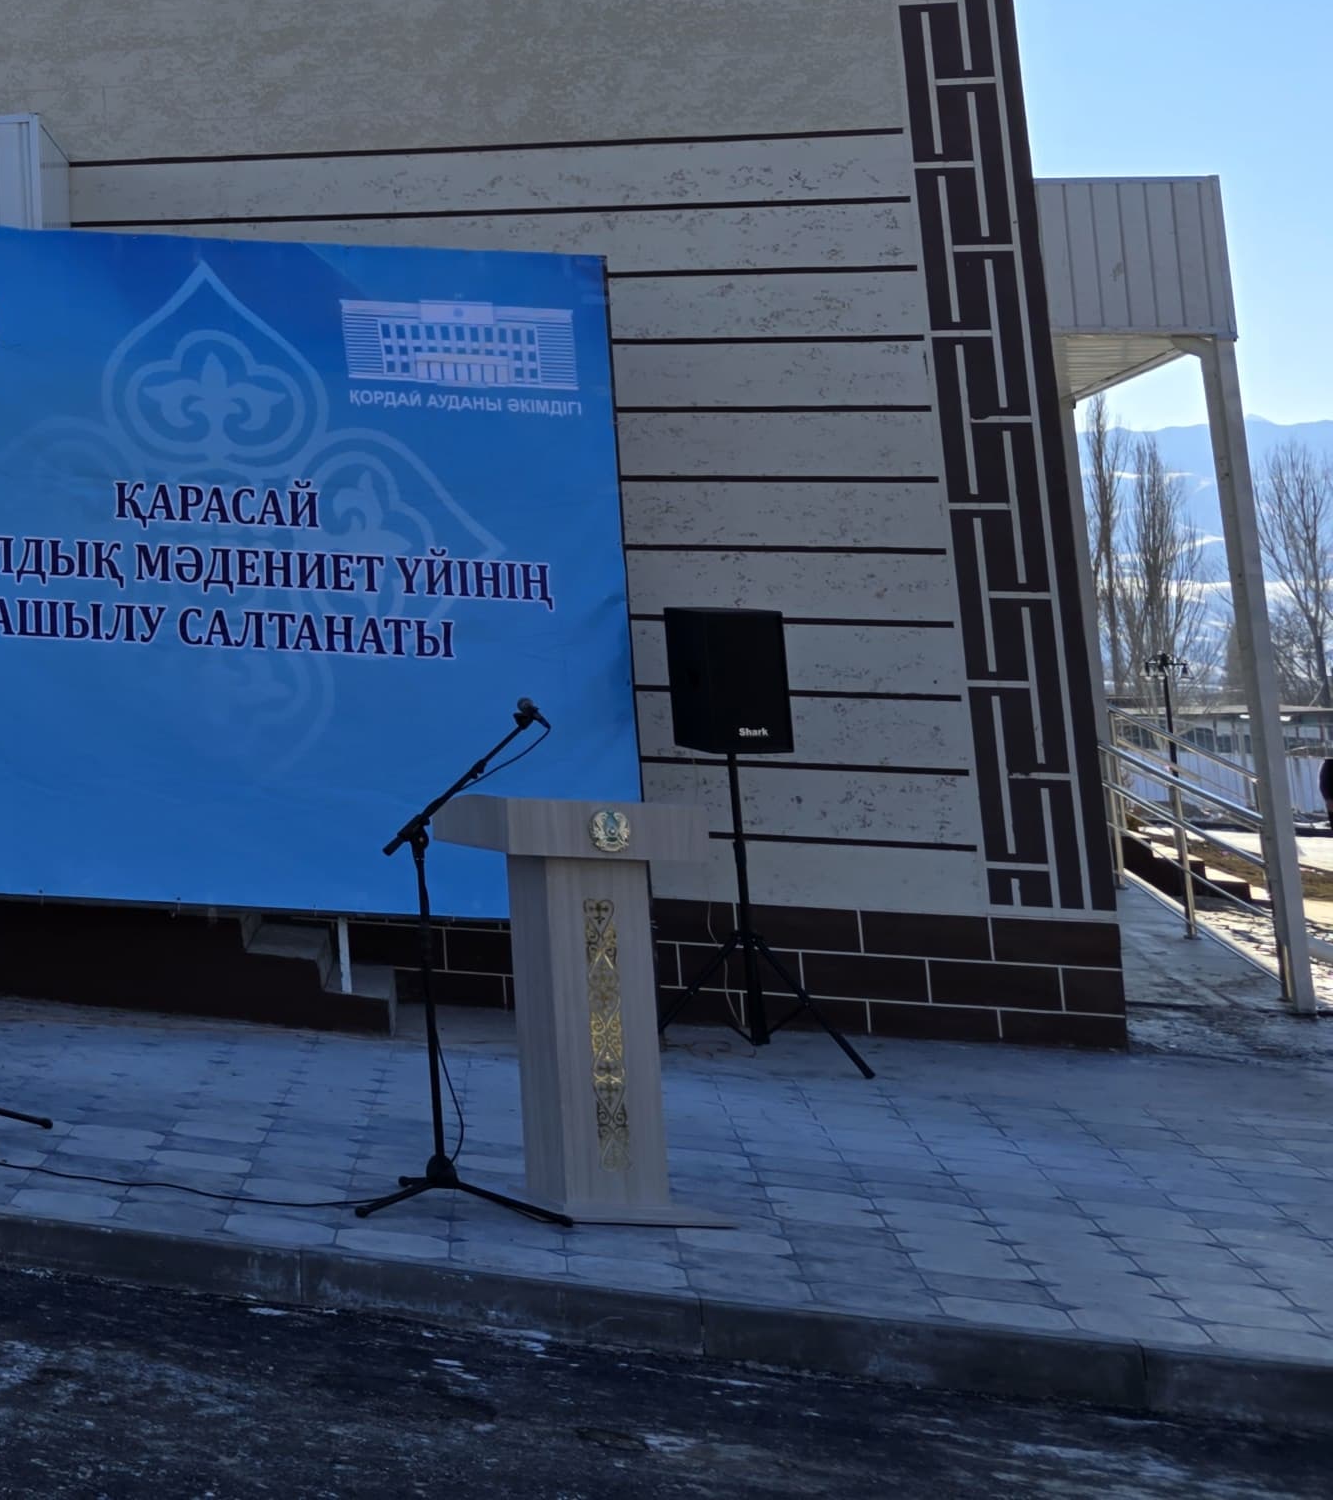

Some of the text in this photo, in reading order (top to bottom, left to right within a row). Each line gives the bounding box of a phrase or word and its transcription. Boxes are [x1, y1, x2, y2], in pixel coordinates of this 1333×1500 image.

[426, 394, 502, 412] АУДАНЫ
[507, 398, 583, 416] ӘКІМДІГІ
[115, 479, 320, 529] ҚАРАСАЙ
[134, 543, 385, 594] МӘДЕНИЕТ
[395, 547, 554, 611] ҮЙІНІҢ
[178, 607, 455, 659] САЛТАНАТЫ
[738, 726, 769, 737] Shark
